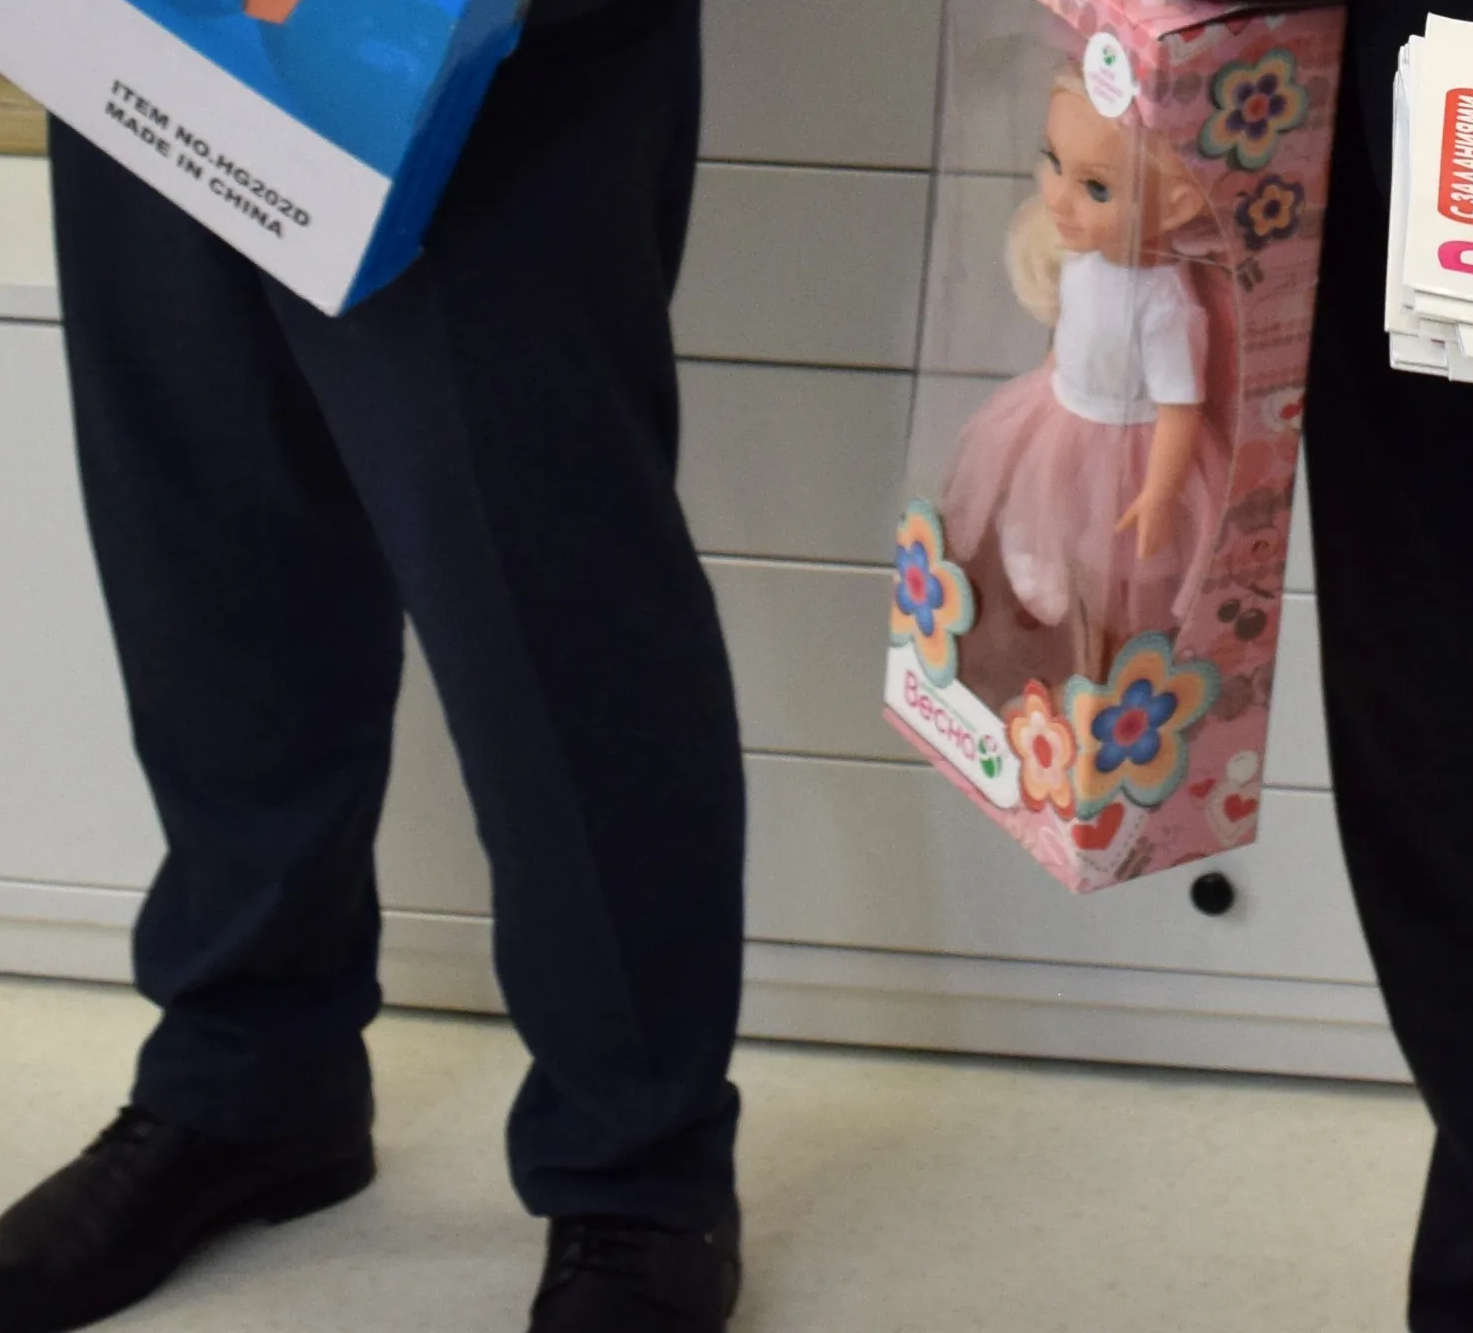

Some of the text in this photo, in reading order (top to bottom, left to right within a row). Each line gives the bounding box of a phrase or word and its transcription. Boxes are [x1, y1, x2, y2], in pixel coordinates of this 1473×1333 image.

[111, 79, 170, 130] ITEM
[105, 101, 284, 239] MADE IN CHINA
[903, 670, 978, 761] Весна
